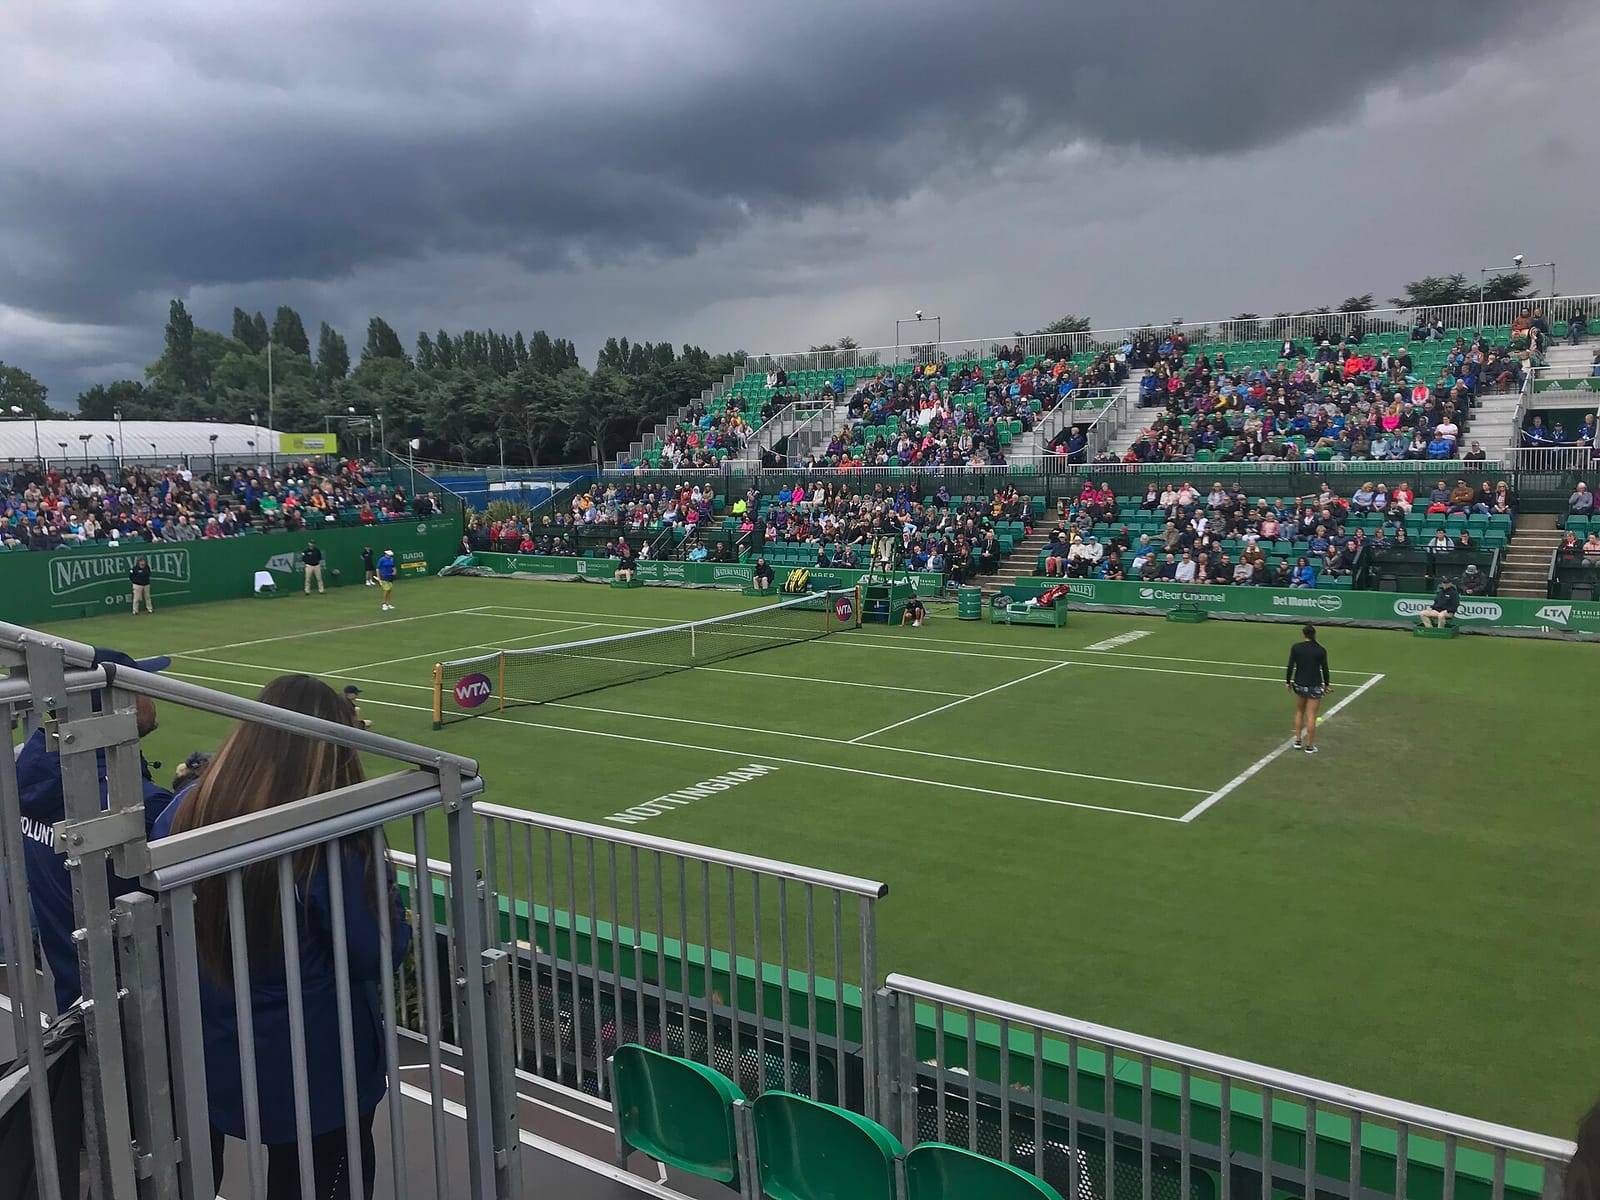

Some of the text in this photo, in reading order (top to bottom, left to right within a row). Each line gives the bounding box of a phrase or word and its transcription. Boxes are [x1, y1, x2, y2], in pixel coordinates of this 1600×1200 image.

[56, 552, 184, 588] NATURE VLLEY
[272, 558, 293, 570] LTA
[1069, 584, 1093, 596] VALLEY
[1154, 589, 1226, 602] Clear Channel
[105, 593, 143, 605] OPE
[1272, 595, 1317, 607] Del Monte
[836, 605, 852, 616] WTA
[1397, 601, 1433, 615] Quor
[1456, 604, 1498, 616] Quorn
[1544, 609, 1568, 621] LTA
[456, 681, 490, 699] WTA
[603, 763, 780, 825] NOTTINGHAM
[20, 815, 54, 848] OLUNT
